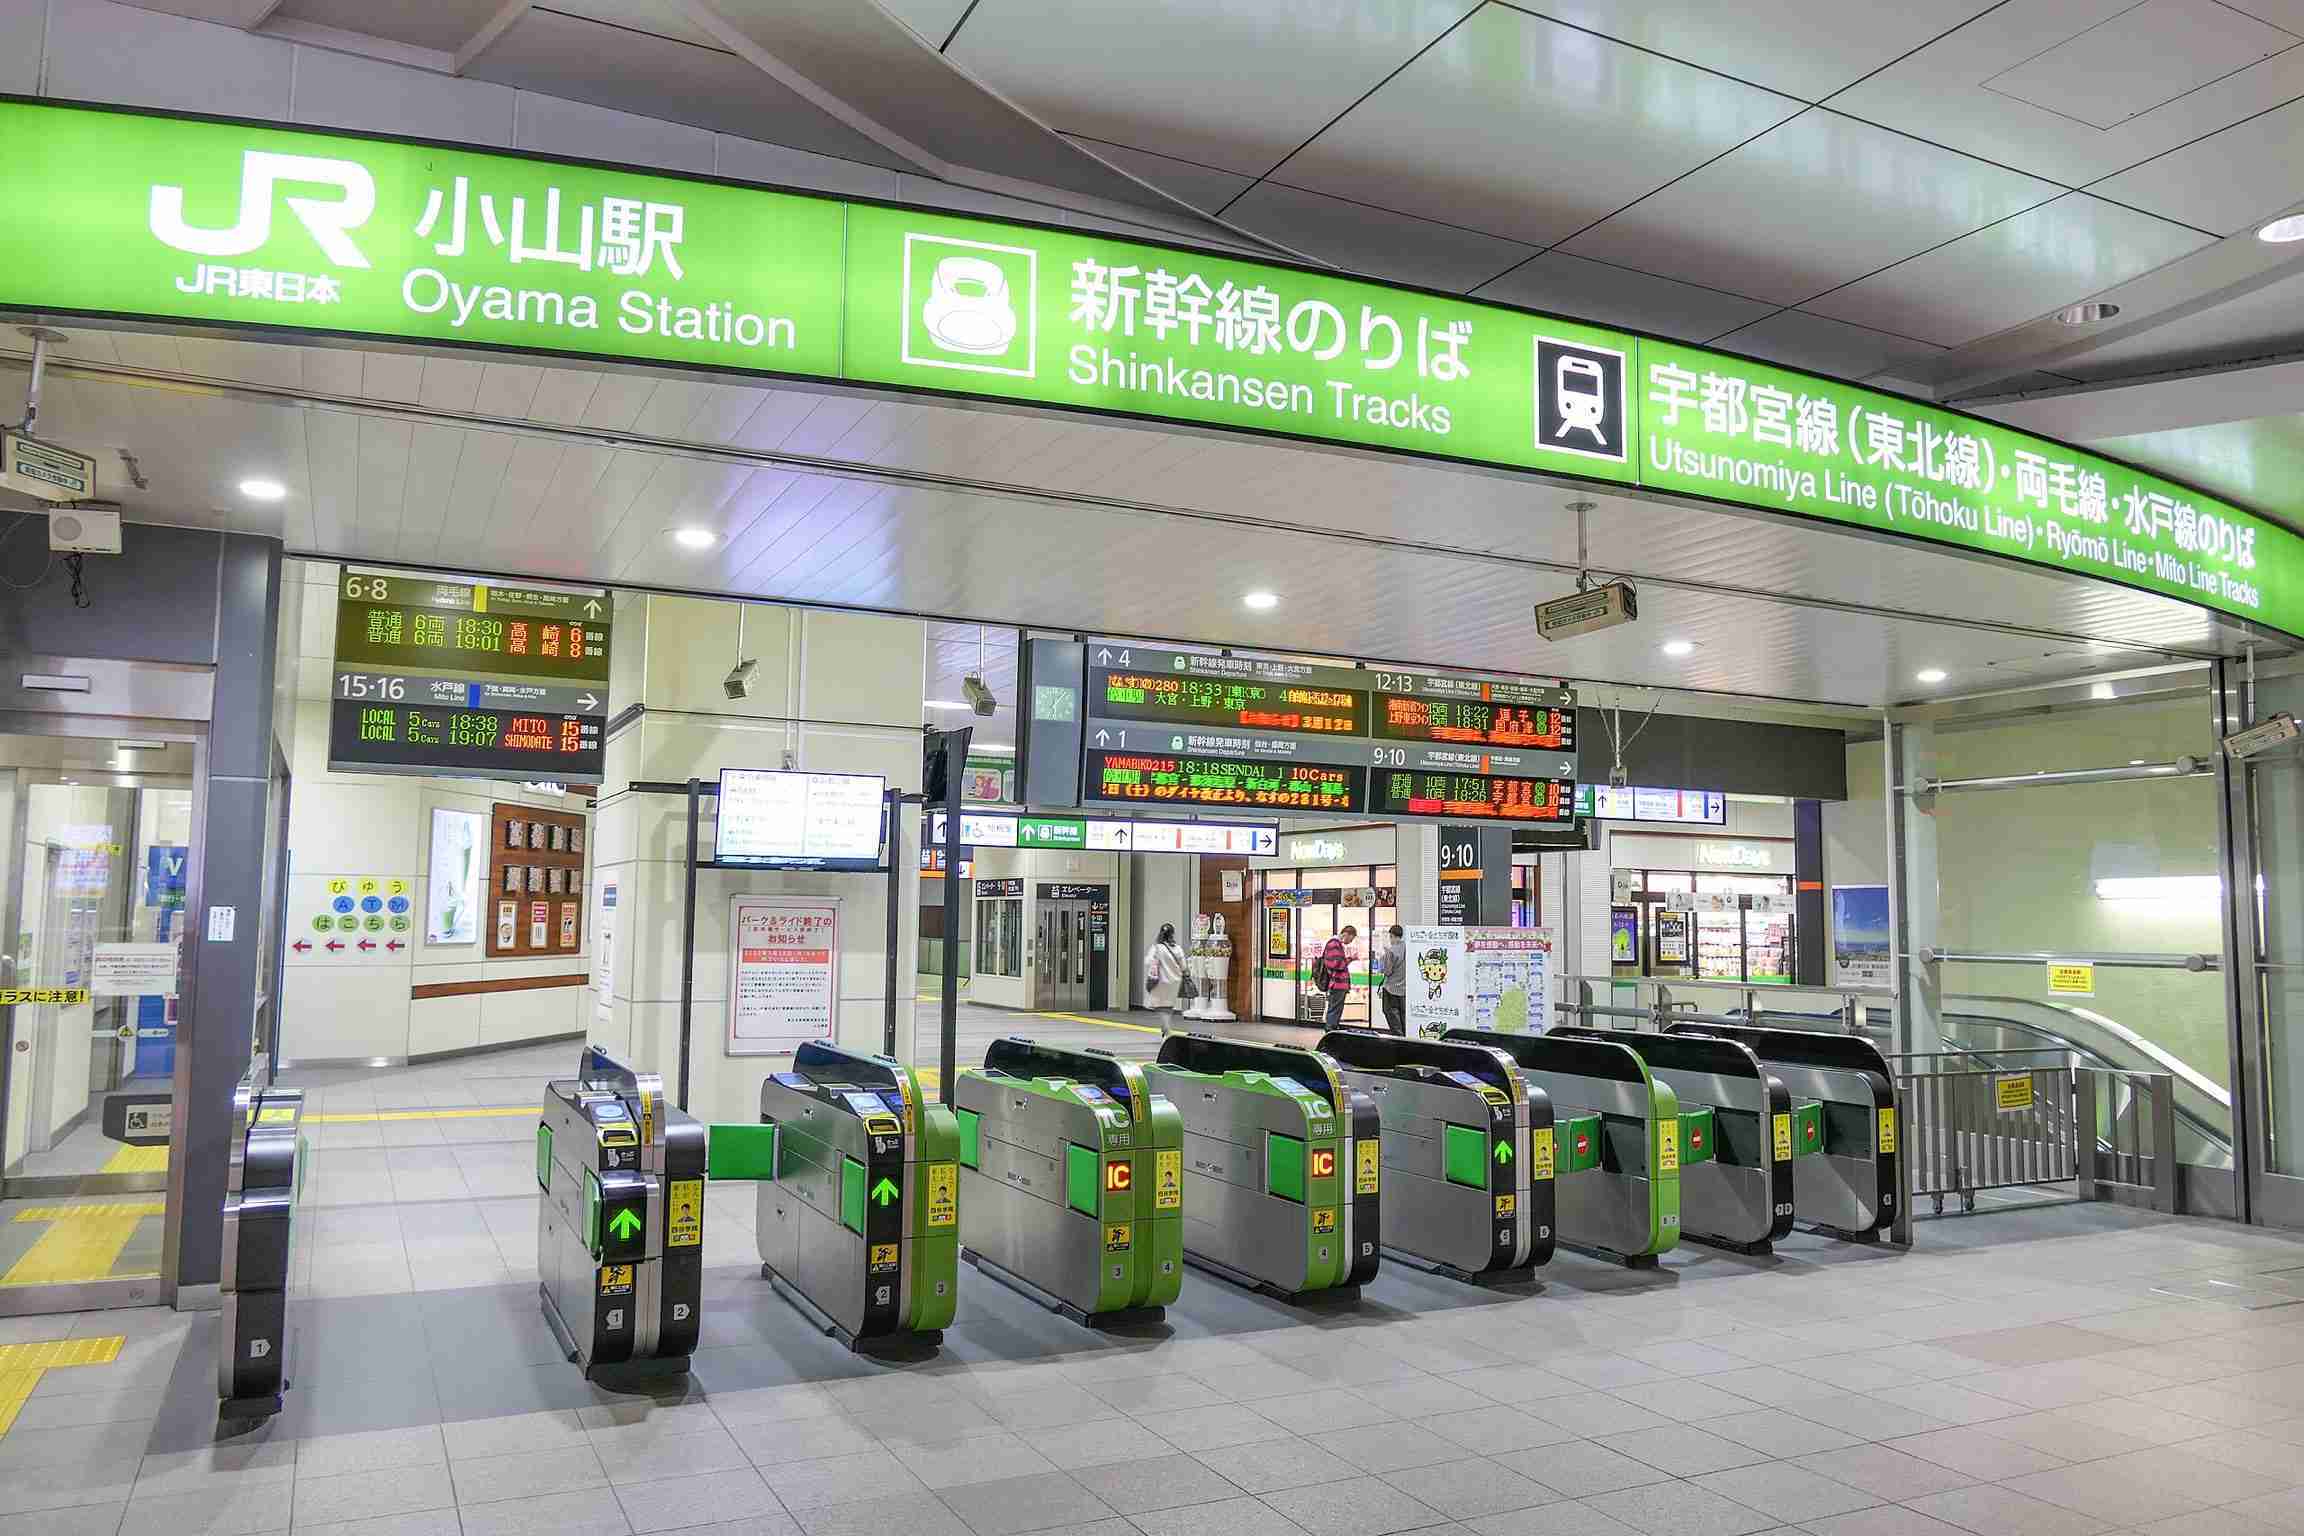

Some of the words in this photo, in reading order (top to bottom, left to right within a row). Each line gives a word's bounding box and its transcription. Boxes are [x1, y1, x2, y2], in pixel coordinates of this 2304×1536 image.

[149, 149, 376, 269] JR
[415, 177, 684, 281] 小山駅
[176, 264, 341, 306] JR東日本
[403, 268, 598, 329] Oyama
[618, 291, 796, 349] Station
[1069, 258, 1473, 381] 新幹線のりば
[1069, 344, 1313, 414] Shinkansen
[1327, 380, 1451, 434] Tracks
[1649, 435, 1816, 501] Utsunomiya
[1824, 470, 1877, 509] Line
[1886, 483, 1978, 531] (Tōhoku
[2189, 562, 2217, 594] Line
[2219, 571, 2259, 608] Tracks
[456, 616, 503, 636] 18:30
[455, 632, 501, 651] 19:01
[1118, 650, 1130, 667] 4
[1181, 680, 1222, 697] 18:33
[361, 708, 397, 726] LOCAL
[449, 714, 498, 732] 18:38
[512, 717, 547, 733] MITO
[1456, 703, 1489, 719] 18:22
[1455, 716, 1489, 730] 18:31
[360, 724, 396, 742] LOCAL
[449, 730, 497, 747] 19:07
[504, 734, 553, 750] SHIMODATE
[1119, 731, 1128, 749] 1
[1178, 760, 1220, 775] 18:18
[1220, 764, 1266, 777] SENDAI
[1455, 777, 1487, 790] 17:51
[1455, 790, 1487, 803] 18:26
[768, 933, 806, 945] お知らせ
[0, 989, 85, 1004] ラスに注意!
[1313, 1152, 1333, 1176] IC
[1107, 1165, 1130, 1189] IC
